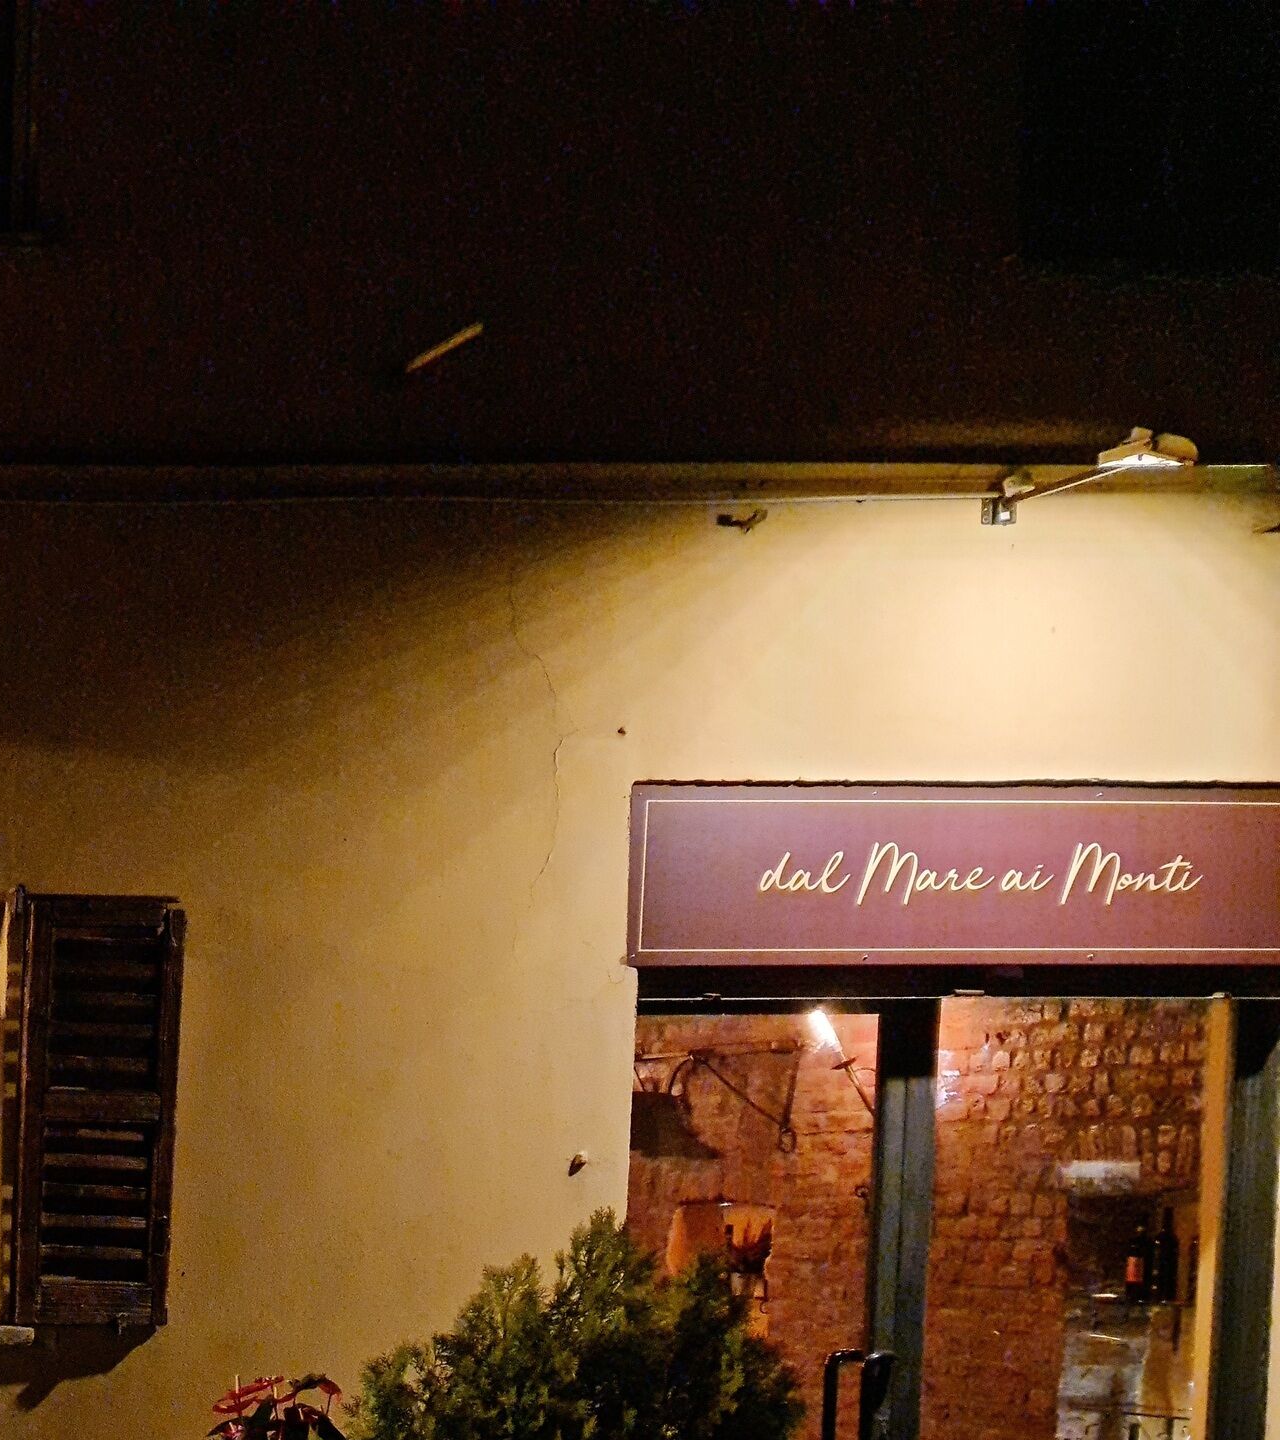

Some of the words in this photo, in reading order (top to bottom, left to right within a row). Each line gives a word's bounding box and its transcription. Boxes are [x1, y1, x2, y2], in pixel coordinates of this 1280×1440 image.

[760, 850, 851, 894] dal
[855, 841, 996, 906] Mare
[998, 862, 1056, 893] ai
[1058, 841, 1204, 906] Monti
